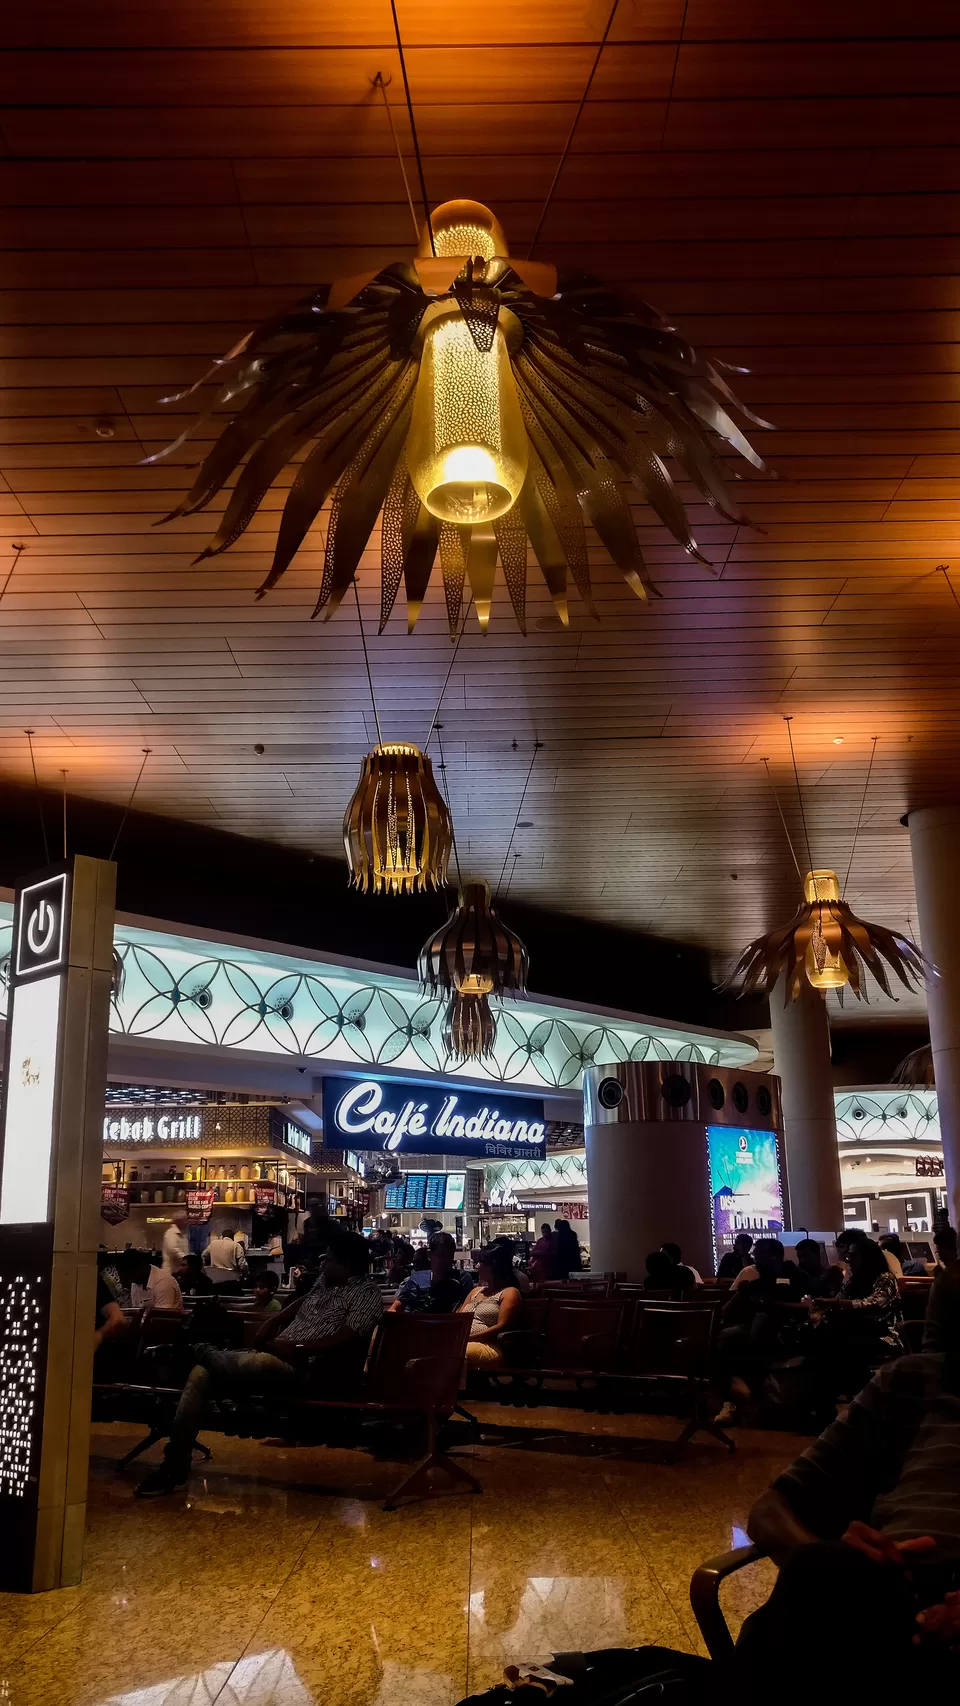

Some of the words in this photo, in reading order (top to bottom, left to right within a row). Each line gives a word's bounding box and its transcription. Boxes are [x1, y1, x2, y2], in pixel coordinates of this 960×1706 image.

[157, 1115, 201, 1139] Grill
[335, 1081, 428, 1150] Café
[431, 1096, 545, 1144] Indiana
